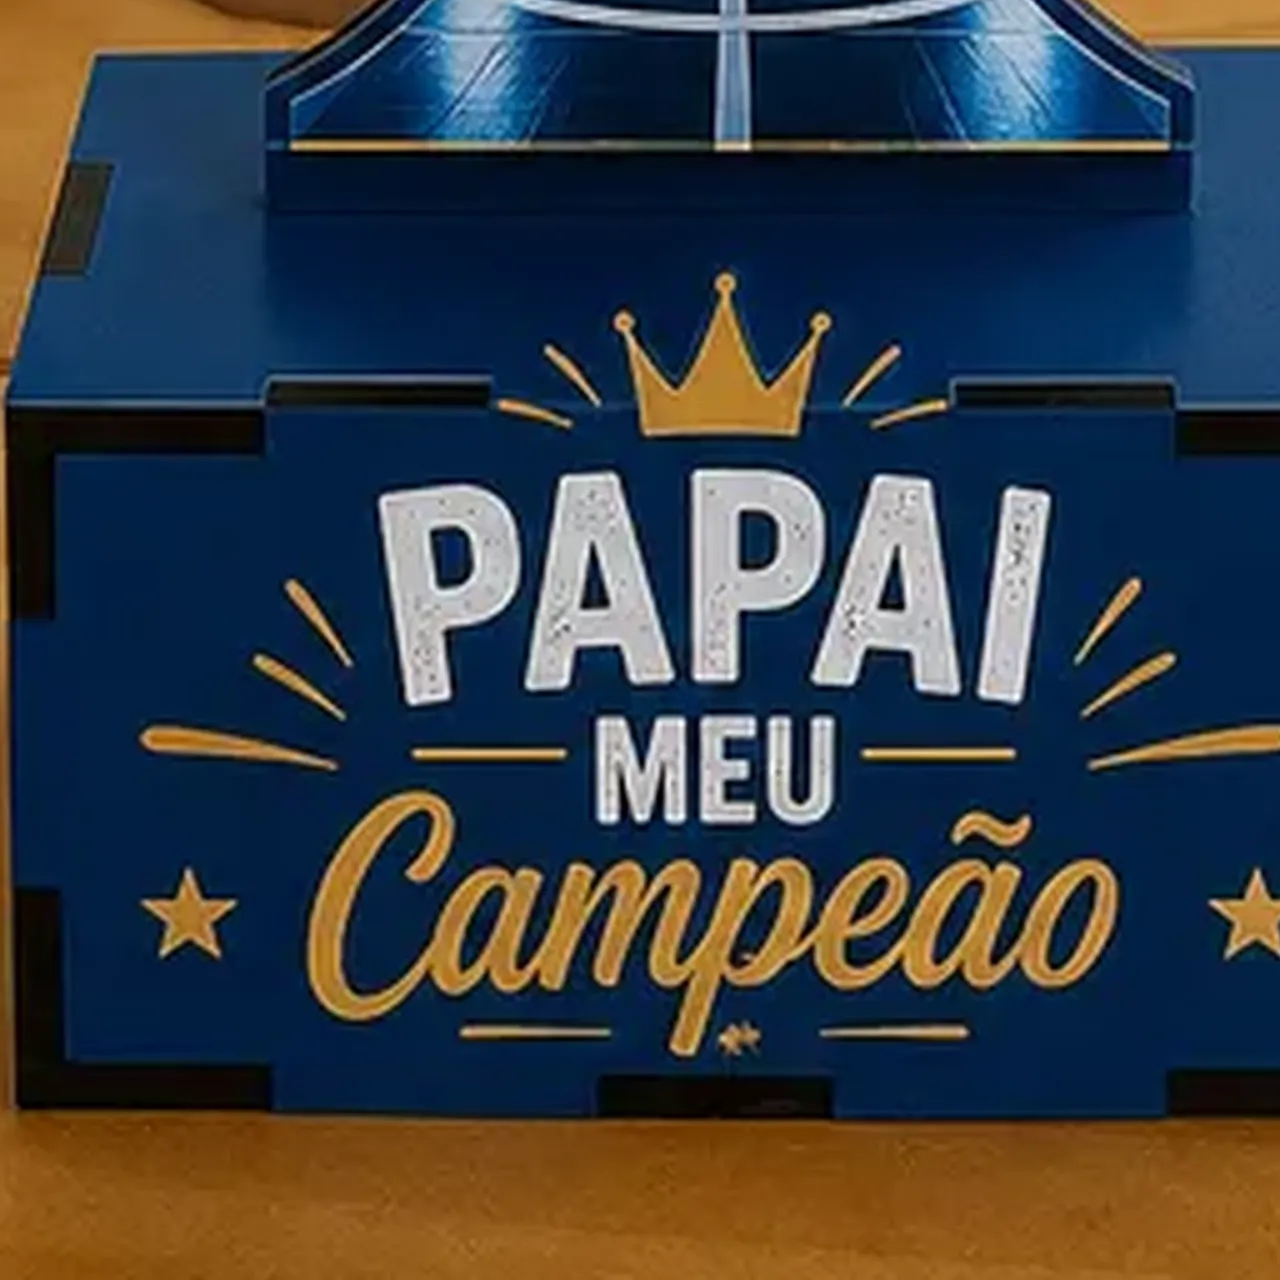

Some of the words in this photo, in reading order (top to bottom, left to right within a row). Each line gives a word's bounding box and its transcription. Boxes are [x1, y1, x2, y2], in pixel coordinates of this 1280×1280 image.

[377, 468, 1052, 705] PAPAI
[595, 715, 837, 825] MEU
[307, 790, 1120, 1057] Campeão
